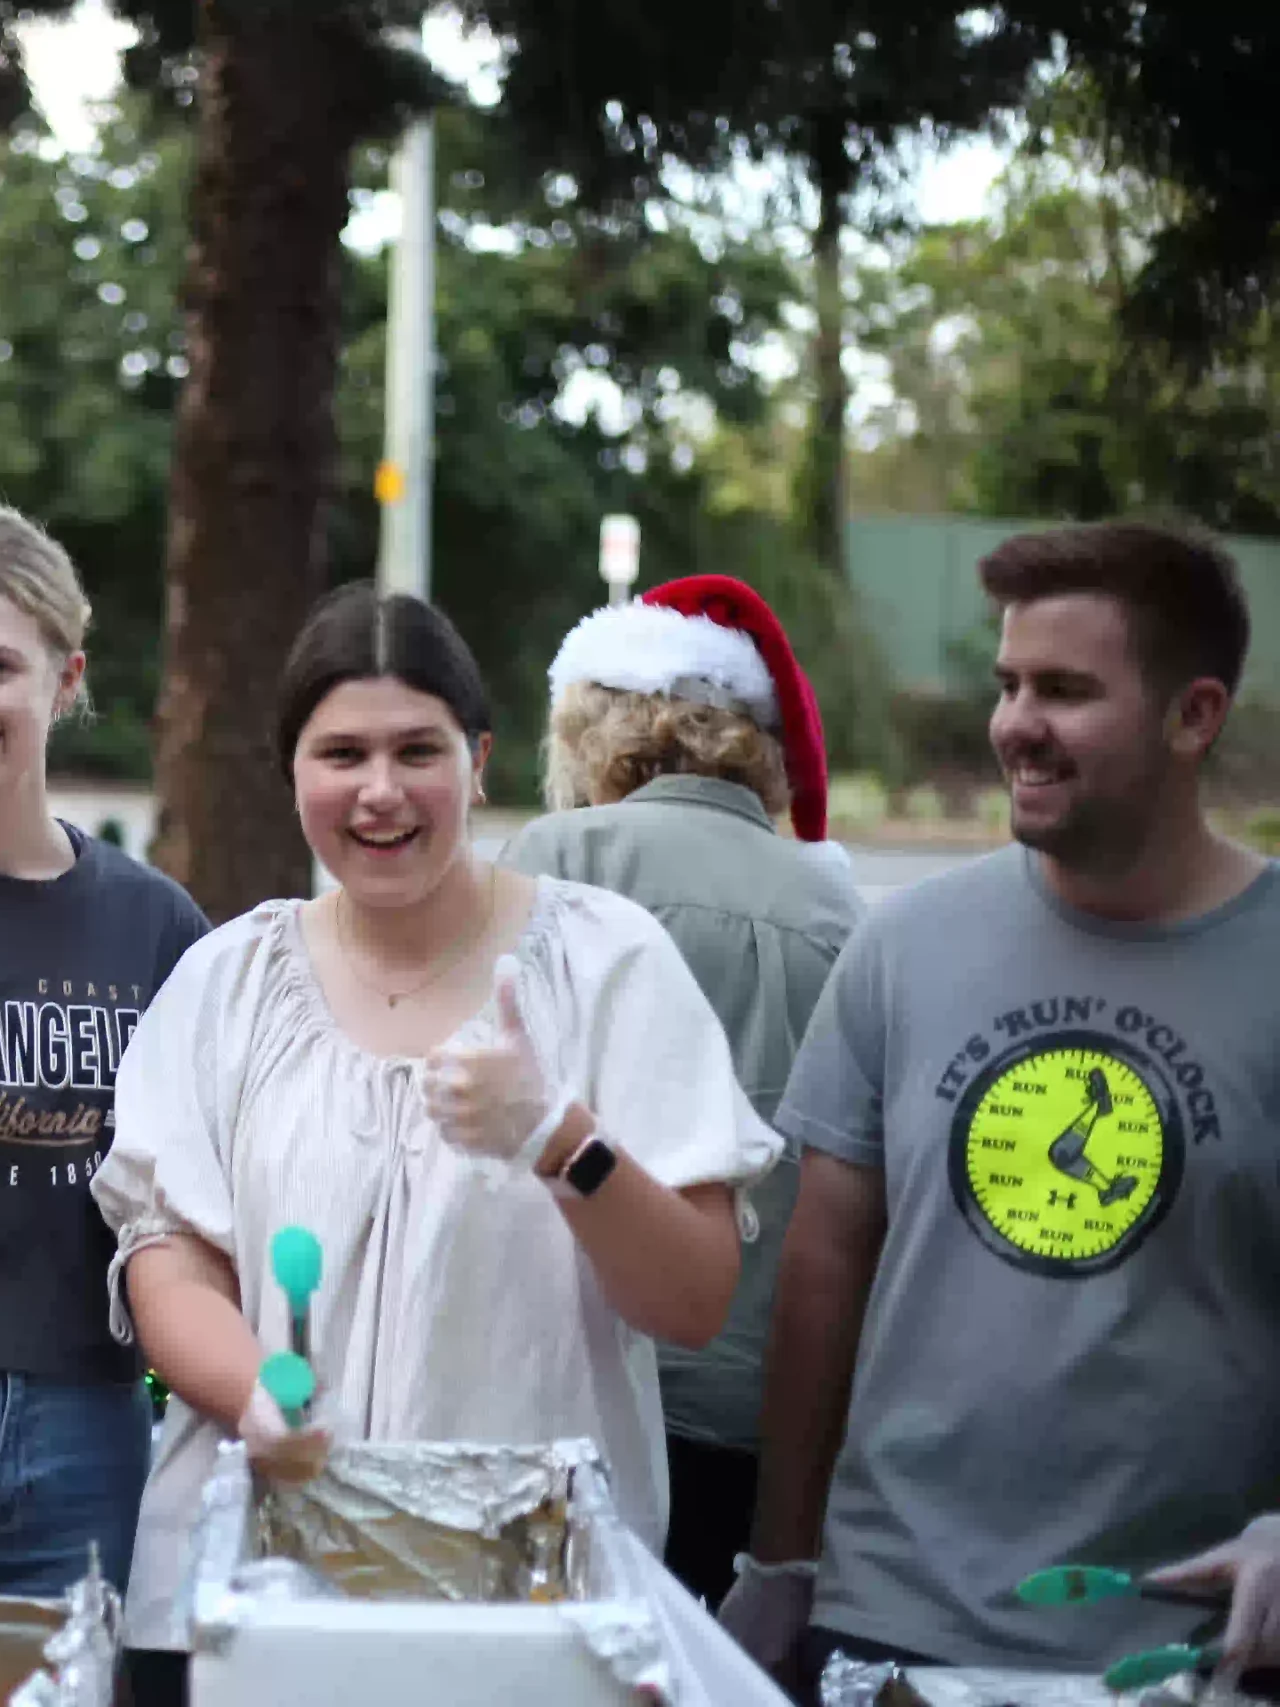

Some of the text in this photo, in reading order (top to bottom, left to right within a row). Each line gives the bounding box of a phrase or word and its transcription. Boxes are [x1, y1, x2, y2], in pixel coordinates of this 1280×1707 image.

[38, 978, 140, 1001] COAST
[935, 1034, 991, 1102] IT'S
[1115, 1005, 1222, 1146] O'CLOCK
[1012, 1081, 1048, 1096] RUN
[989, 1104, 1024, 1118] RUN
[1118, 1120, 1149, 1133] RUN
[981, 1136, 1017, 1153] RUN
[1116, 1155, 1149, 1169] RUN
[988, 1172, 1024, 1188] RUN
[1006, 1207, 1040, 1223] RUN
[1083, 1218, 1115, 1232] RUN
[1039, 1227, 1074, 1243] RUN
